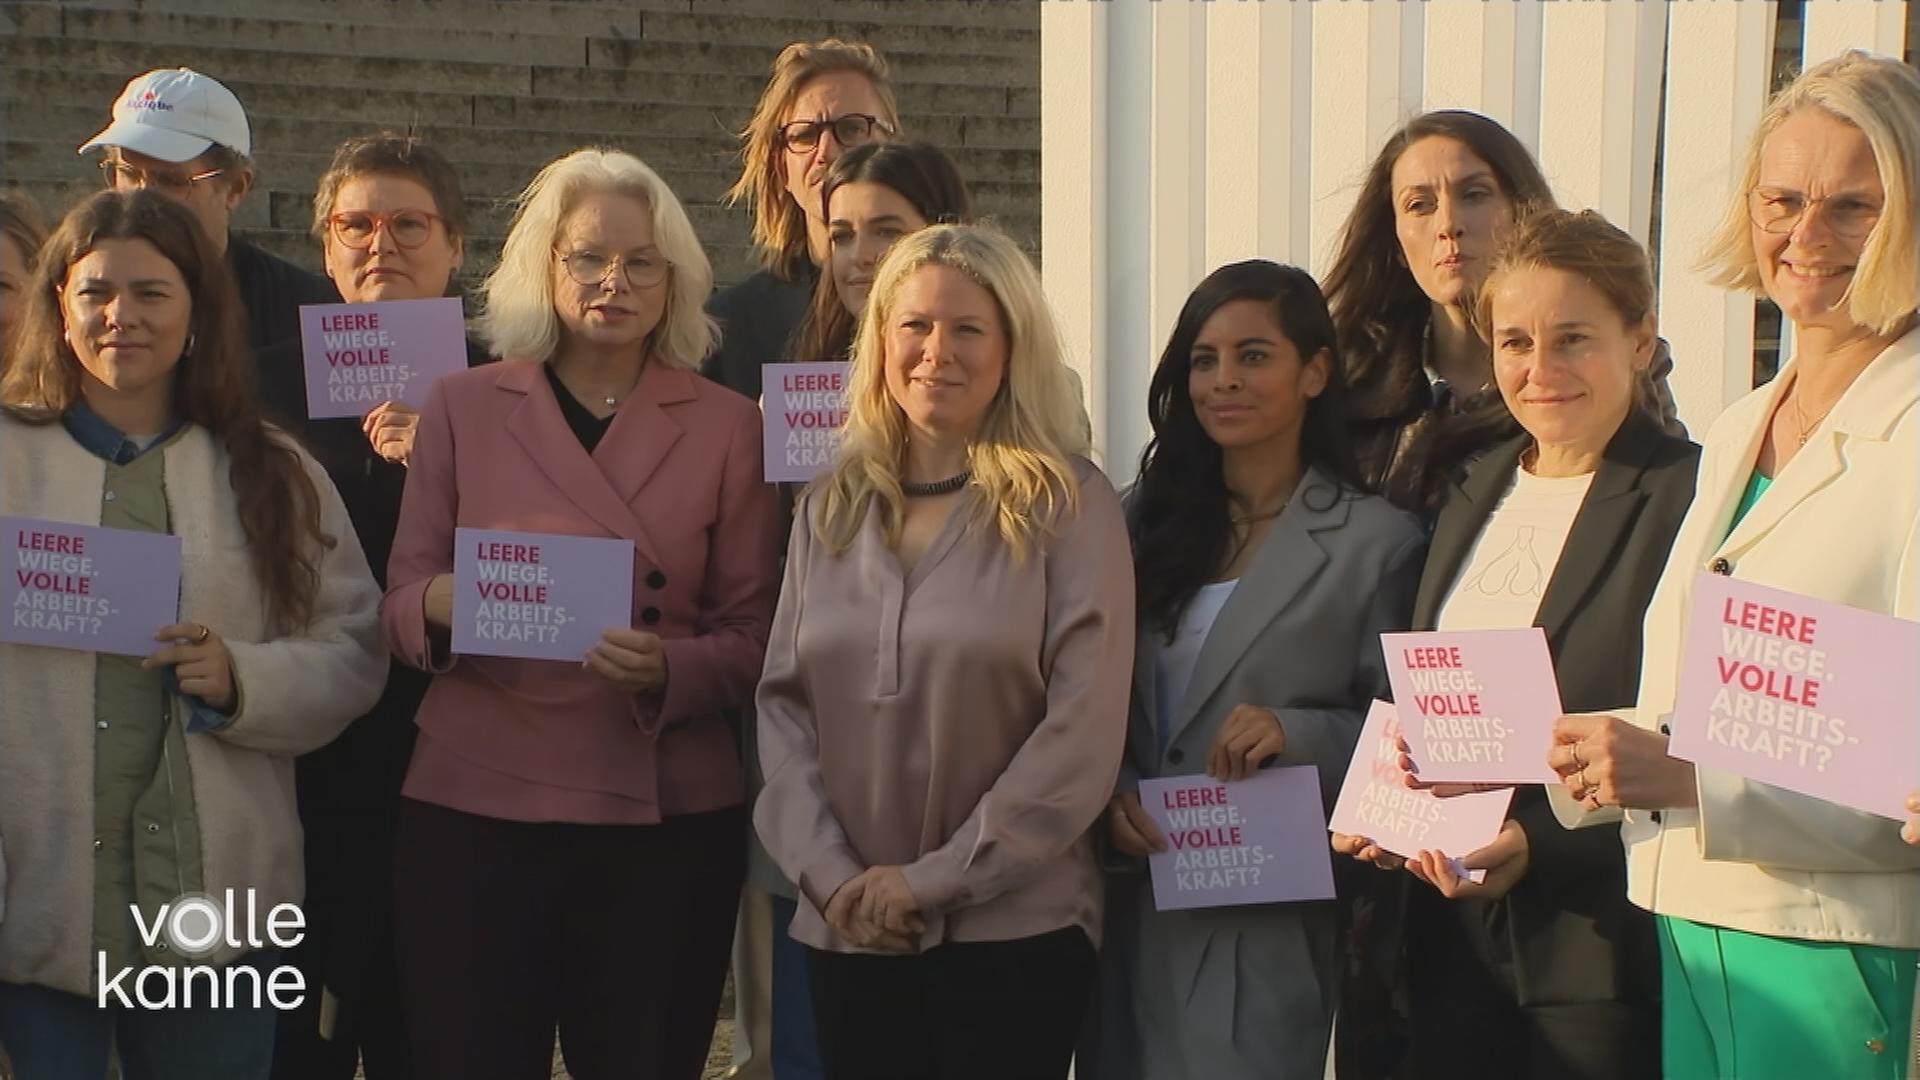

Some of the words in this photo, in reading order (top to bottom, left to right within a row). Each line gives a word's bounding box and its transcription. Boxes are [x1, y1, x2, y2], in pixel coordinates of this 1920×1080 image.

[321, 313, 379, 332] LEERE
[324, 331, 396, 349] WIEGE.
[325, 349, 390, 368] VOLLE
[328, 365, 418, 385] ARBEITS-
[329, 383, 405, 402] KRAFT?
[18, 530, 85, 554] LEERE
[477, 542, 540, 564] LEERE
[18, 552, 99, 576] WIEGE.
[478, 562, 555, 584] WIEGE.
[16, 570, 91, 594] VOLLE
[476, 581, 547, 603] VOLLE
[14, 590, 120, 616] ARBEITS-
[475, 602, 576, 625] ARBEITS-
[13, 609, 102, 634] KRAFT?
[475, 620, 560, 643] KRAFT?
[1723, 597, 1817, 644] LEERE
[1404, 647, 1462, 669] LEERE
[1722, 627, 1834, 681] WIEGE.
[1408, 670, 1483, 692] WIEGE.
[1717, 656, 1820, 708] VOLLE
[1414, 695, 1481, 716] VOLLE
[1709, 687, 1859, 745] ARBEITS-
[1423, 718, 1514, 739] ARBEITS-
[1425, 741, 1504, 763] KRAFT?
[1707, 716, 1833, 772] KRAFT?
[1163, 786, 1228, 810] LEERE
[1360, 782, 1448, 822] ARBEITS-
[1165, 806, 1247, 829] WIEGE.
[1355, 801, 1430, 841] KRAFT?
[1169, 827, 1242, 850] VOLLE
[1174, 846, 1274, 871] ARBEITS-
[1176, 867, 1261, 891] KRAFT?
